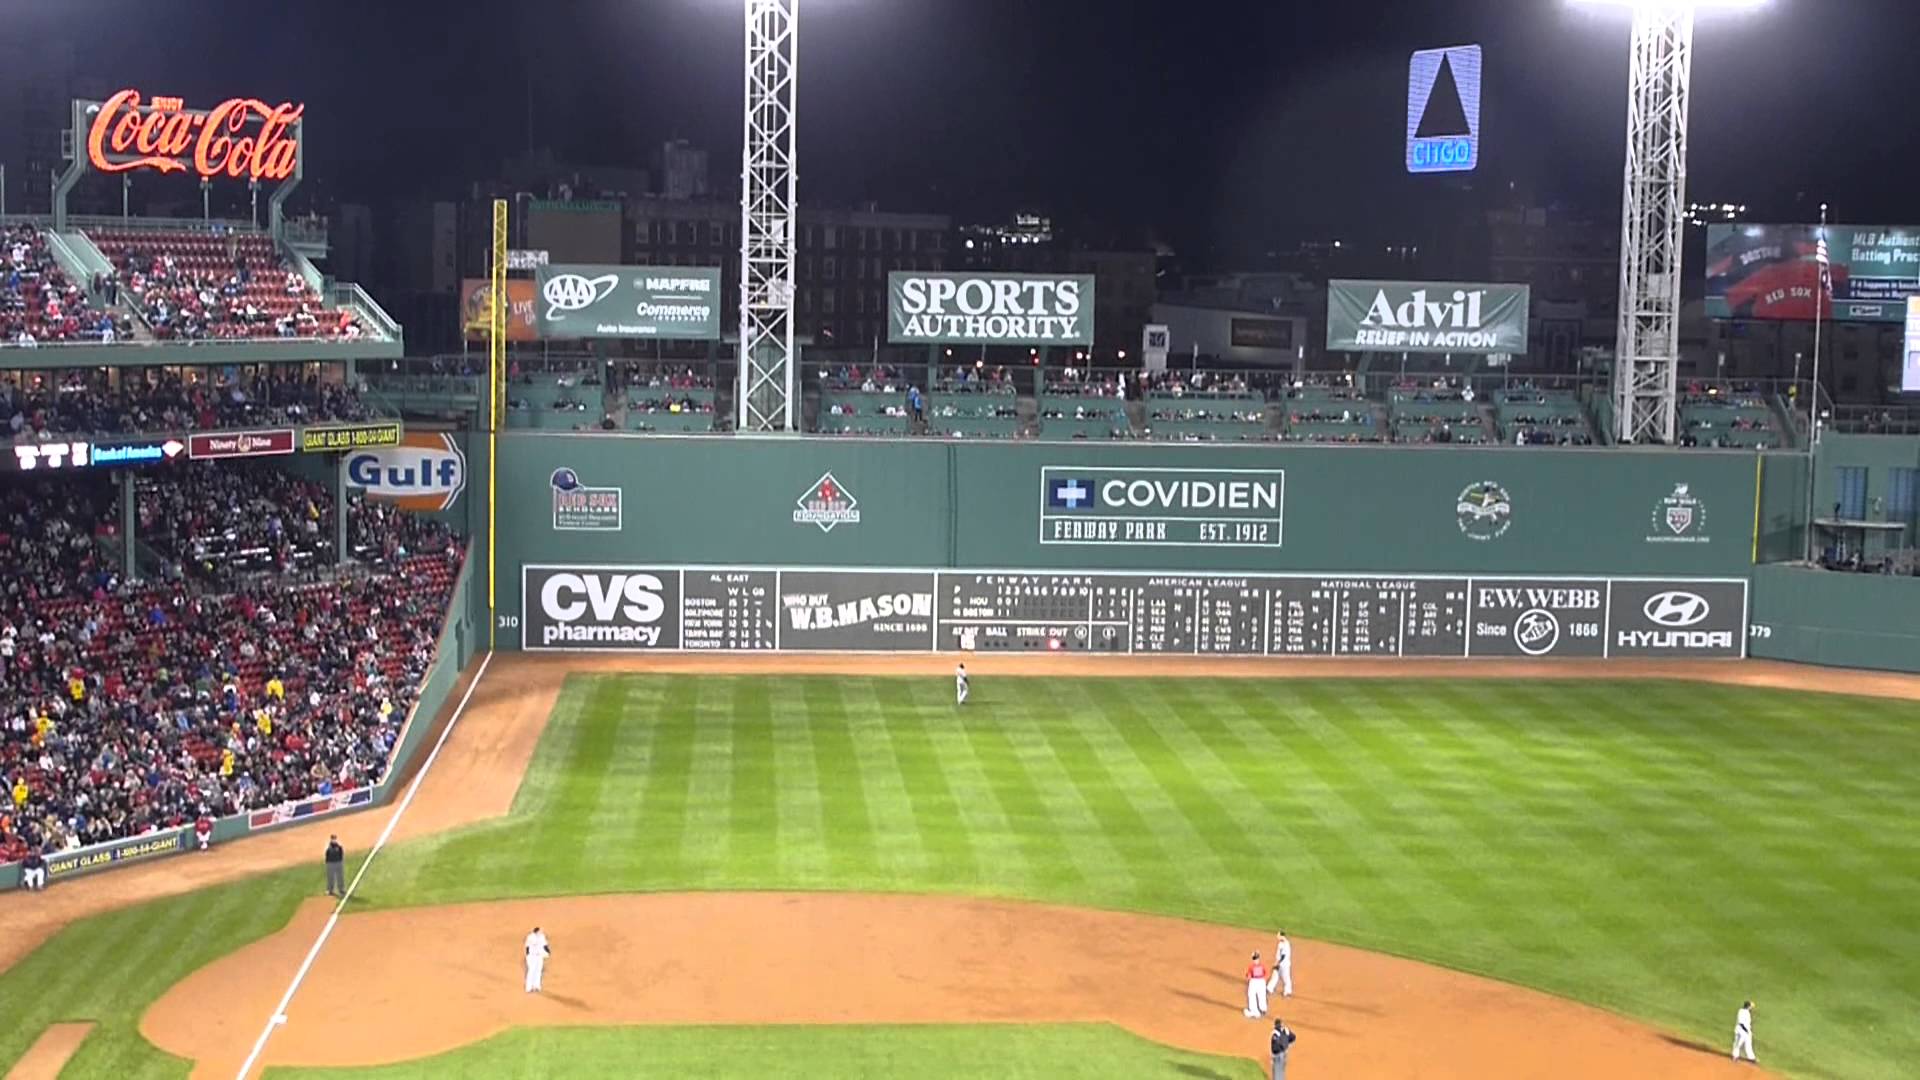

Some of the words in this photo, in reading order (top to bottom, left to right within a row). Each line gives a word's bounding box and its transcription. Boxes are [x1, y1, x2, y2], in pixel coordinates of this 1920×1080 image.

[88, 90, 304, 178] Coca-Cola
[1413, 142, 1469, 165] CITGO
[1852, 248, 1891, 264] Batting
[646, 278, 710, 292] MAPFRE
[1790, 287, 1811, 298] SOX
[902, 278, 1080, 315] SPORTS
[637, 302, 710, 316] Commerce
[1360, 288, 1482, 328] Advil
[597, 323, 617, 332] Auto
[903, 315, 1079, 338] AUTHORITY
[1355, 330, 1408, 345] RELIEF
[1409, 332, 1429, 346] IN
[1433, 332, 1497, 347] ACTION
[349, 455, 455, 486] Gulf
[1102, 480, 1276, 508] COVIDIEN
[1054, 521, 1117, 539] FENWAY
[1125, 522, 1166, 540] PARK
[1200, 523, 1231, 541] EST.
[1236, 524, 1268, 541] 1912
[710, 574, 722, 582] AL
[726, 574, 750, 582] EAST
[976, 576, 1039, 585] FENWAY
[1051, 577, 1092, 585] PARK
[1149, 578, 1202, 587] AMERICAN
[1207, 579, 1247, 587] LEAGUE
[1321, 581, 1371, 589] NATIONAL
[1376, 581, 1416, 589] LEAGUE
[541, 573, 664, 622] CVS
[727, 587, 739, 596] W
[742, 587, 749, 596] L
[1005, 586, 1011, 595] 2
[1014, 586, 1020, 596] 3
[1025, 586, 1031, 596] 4
[1033, 586, 1039, 596] 5
[1041, 586, 1047, 596] 6
[1053, 587, 1058, 596] 7
[1478, 588, 1523, 608] F.W.
[1526, 588, 1600, 608] WEBB
[970, 597, 988, 606] HOU
[498, 615, 518, 628] 310
[874, 623, 903, 632] SINCE
[1476, 622, 1507, 636] Since
[543, 621, 661, 645] pharmacy
[986, 627, 1008, 636] BALL
[1017, 627, 1046, 636] STRIKE
[1049, 627, 1068, 636] OUT
[1618, 631, 1732, 647] HYUNDAI
[49, 858, 79, 873] GIANT
[80, 851, 111, 867] GLASS
